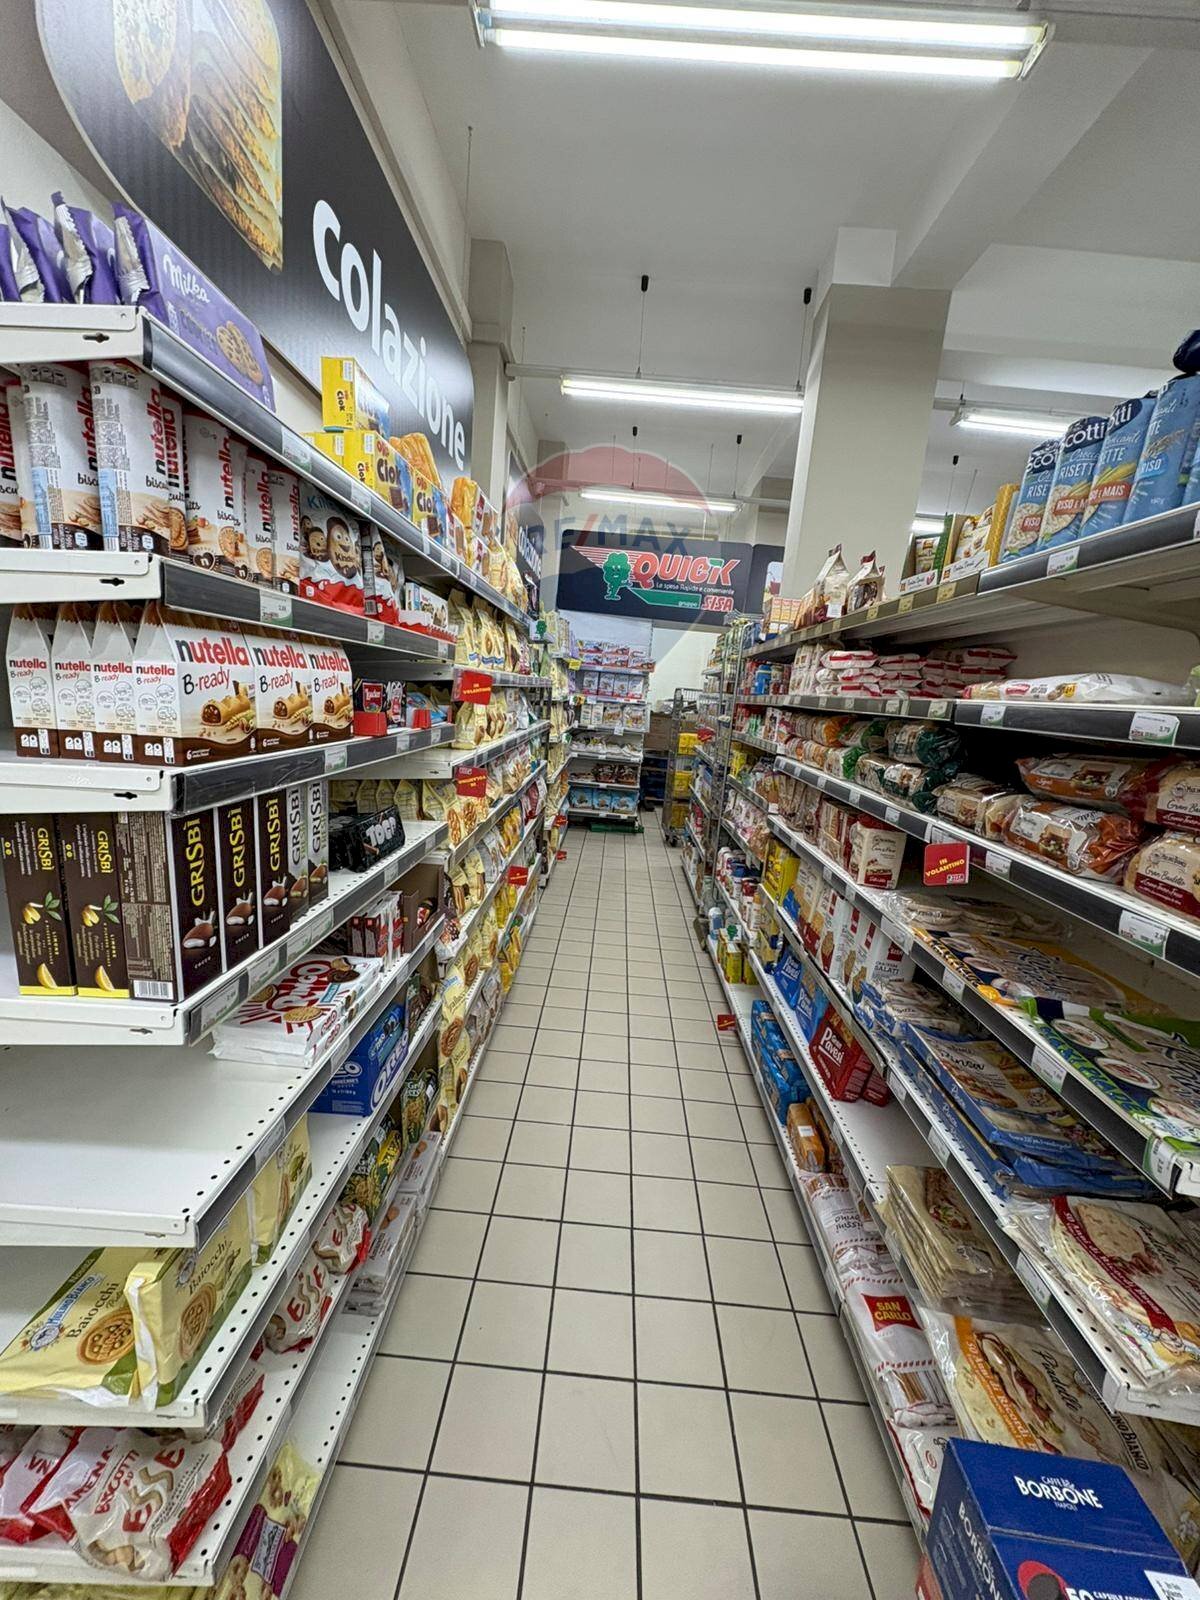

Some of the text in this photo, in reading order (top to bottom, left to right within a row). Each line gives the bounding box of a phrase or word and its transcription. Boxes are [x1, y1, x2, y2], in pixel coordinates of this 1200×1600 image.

[163, 253, 211, 303] Milka
[312, 199, 466, 470] Colazione
[146, 388, 167, 476] nutella
[218, 436, 234, 509] nutella
[256, 471, 272, 532] nutella
[1102, 484, 1125, 497] MAIS
[1056, 499, 1074, 510] RISO
[1024, 516, 1041, 527] RISO
[633, 551, 740, 590] QUICK
[701, 594, 734, 612] SISA
[175, 634, 250, 666] nutella
[252, 643, 307, 669] nutella
[310, 651, 349, 672] nutella
[9, 659, 47, 669] nutella
[55, 661, 91, 671] nutella
[93, 662, 132, 674] nutella
[136, 664, 175, 676] nutella
[924, 858, 965, 877] VOLANTINO
[939, 858, 948, 866] IN
[874, 964, 899, 976] SALATI
[821, 1027, 845, 1063] Pavesi
[188, 1236, 229, 1294] Baiocchi
[1073, 1222, 1091, 1247] Anni
[1100, 1255, 1135, 1290] Ricordi
[65, 1282, 119, 1340] Baiocchi
[875, 1309, 912, 1321] CARLO
[876, 1301, 900, 1311] SAN
[997, 1395, 1030, 1438] Ricordi
[94, 1449, 140, 1514] BISCOTTI
[123, 1471, 134, 1487] AD
[1014, 1475, 1104, 1509] BORBONE
